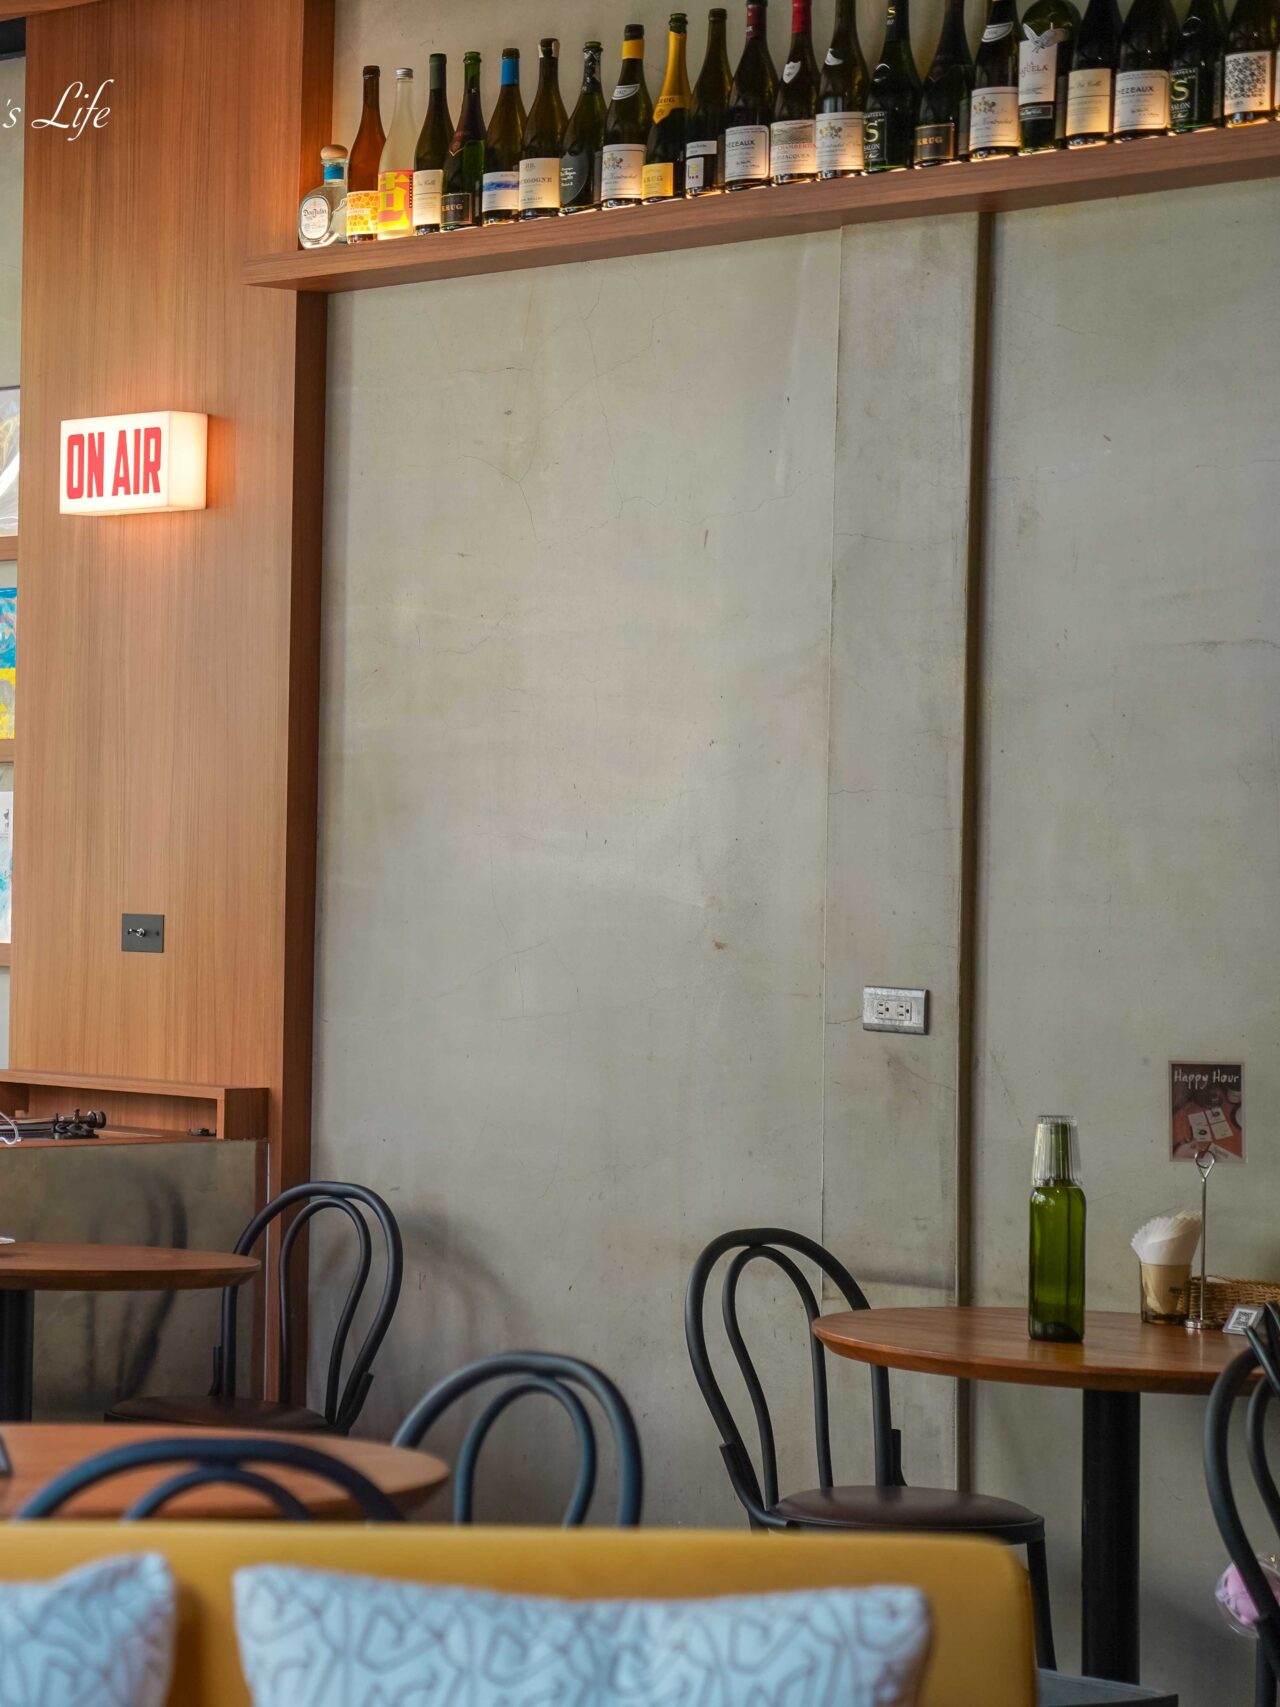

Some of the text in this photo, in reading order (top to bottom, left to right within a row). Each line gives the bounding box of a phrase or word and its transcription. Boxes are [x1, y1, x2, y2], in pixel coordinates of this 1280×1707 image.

[66, 427, 162, 500] ON AIR
[1174, 1068, 1240, 1090] Happy Hour
